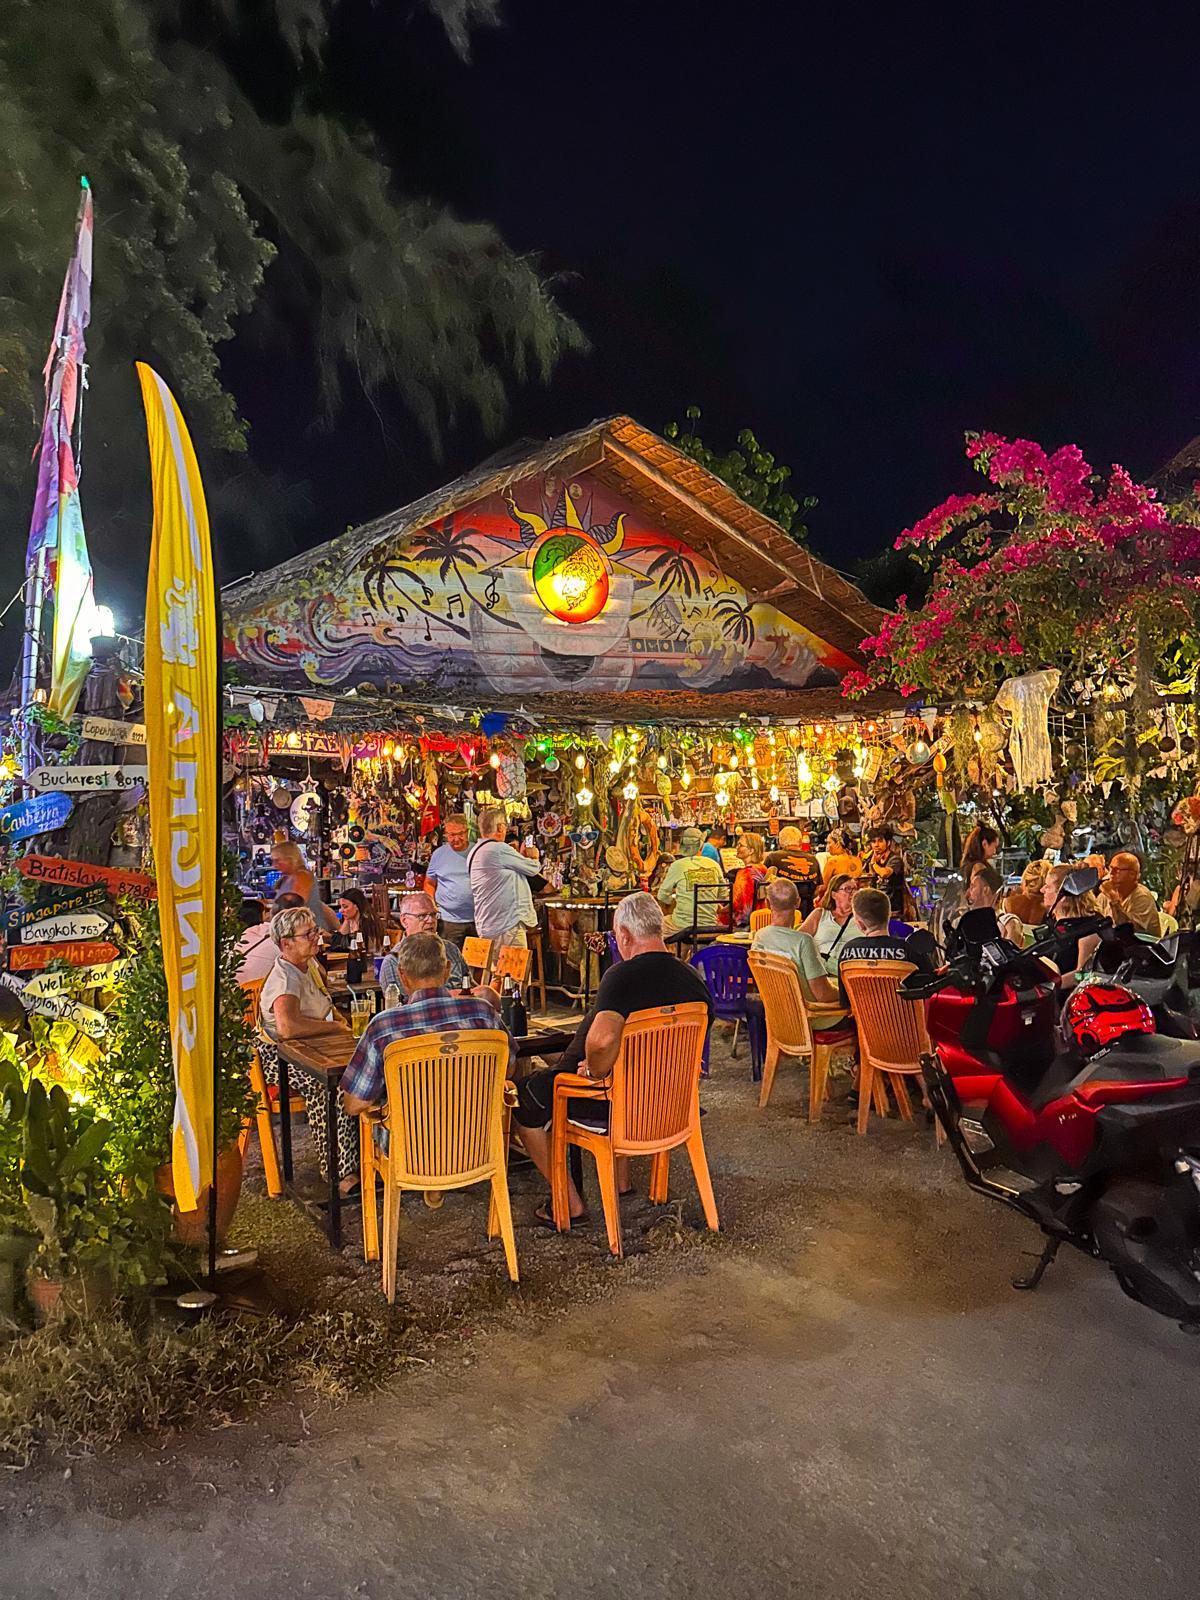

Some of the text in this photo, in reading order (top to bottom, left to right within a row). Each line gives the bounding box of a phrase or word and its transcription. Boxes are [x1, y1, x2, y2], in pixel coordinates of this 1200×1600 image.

[39, 770, 110, 787] Bucharest
[1, 807, 60, 833] Canberra
[8, 896, 83, 927] Singapore
[24, 922, 77, 940] Bangkok
[80, 925, 99, 936] 763
[841, 947, 906, 960] HAWKINS
